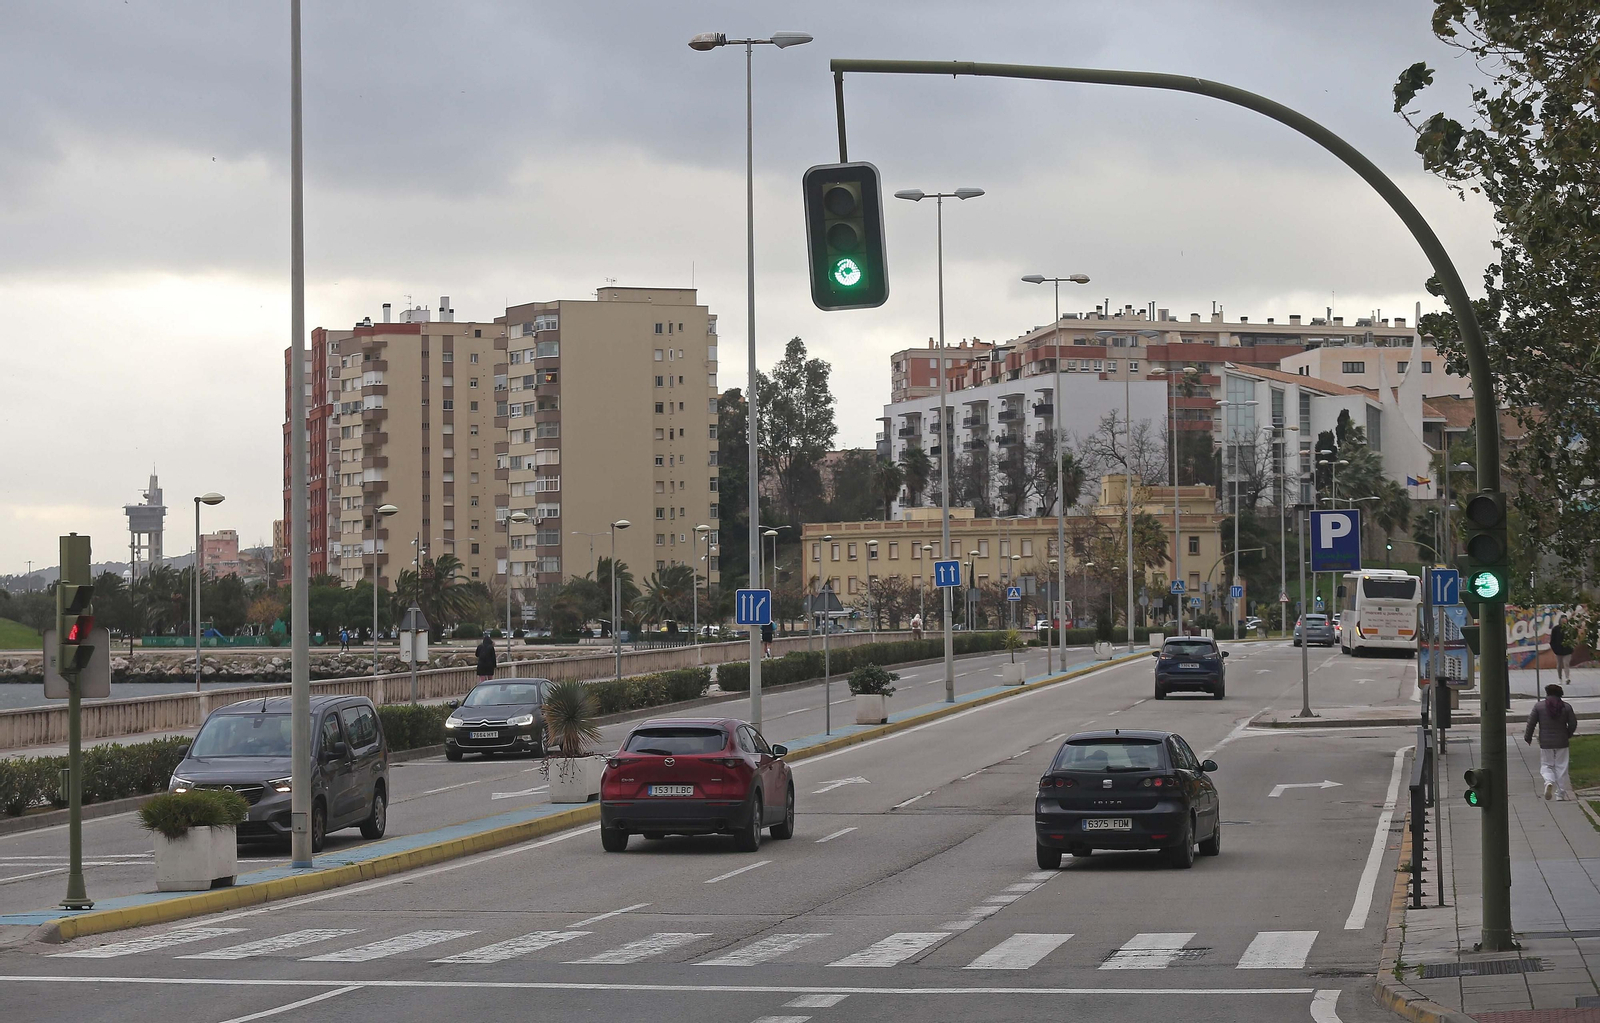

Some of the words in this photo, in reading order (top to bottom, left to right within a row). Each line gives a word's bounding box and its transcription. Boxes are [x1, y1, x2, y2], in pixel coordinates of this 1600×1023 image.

[1320, 513, 1352, 549] P
[654, 786, 674, 794] 1531
[675, 786, 692, 794] LBC
[1088, 820, 1109, 828] 6375
